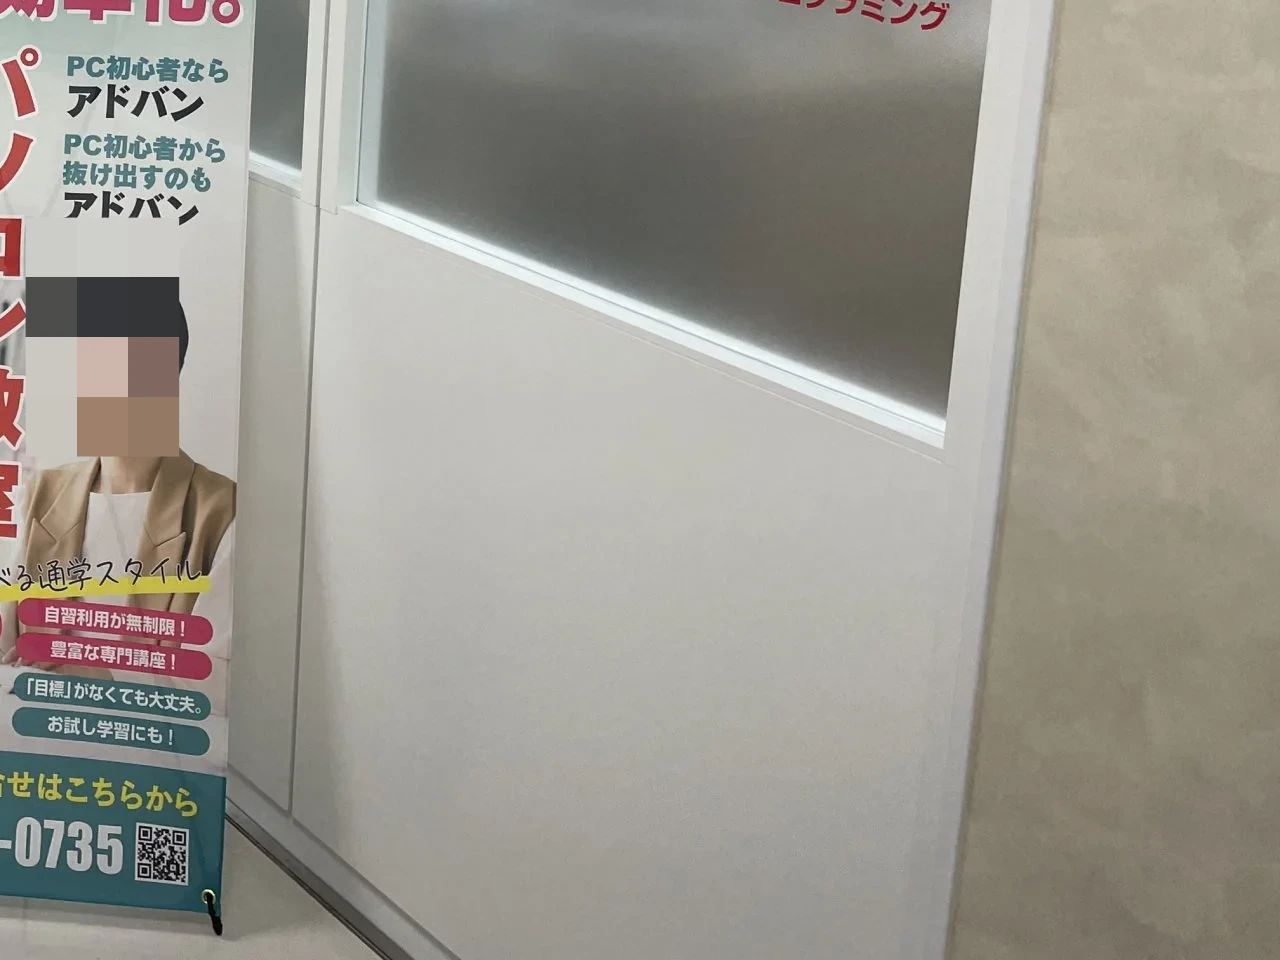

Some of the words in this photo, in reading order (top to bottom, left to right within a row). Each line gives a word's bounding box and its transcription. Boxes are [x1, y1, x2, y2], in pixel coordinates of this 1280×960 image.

[67, 55, 229, 83] PC初心者なら
[67, 84, 204, 122] アドバン
[63, 134, 226, 163] PC初心者から
[62, 161, 211, 192] 抜け出すのも
[64, 192, 199, 225] アドバン
[44, 606, 185, 637] 自習利用が無制限！
[51, 641, 176, 670] 豊富な専門講座！
[26, 678, 202, 714] 「目標」がなくても大丈夫。
[47, 716, 174, 745] お試し学習にも！
